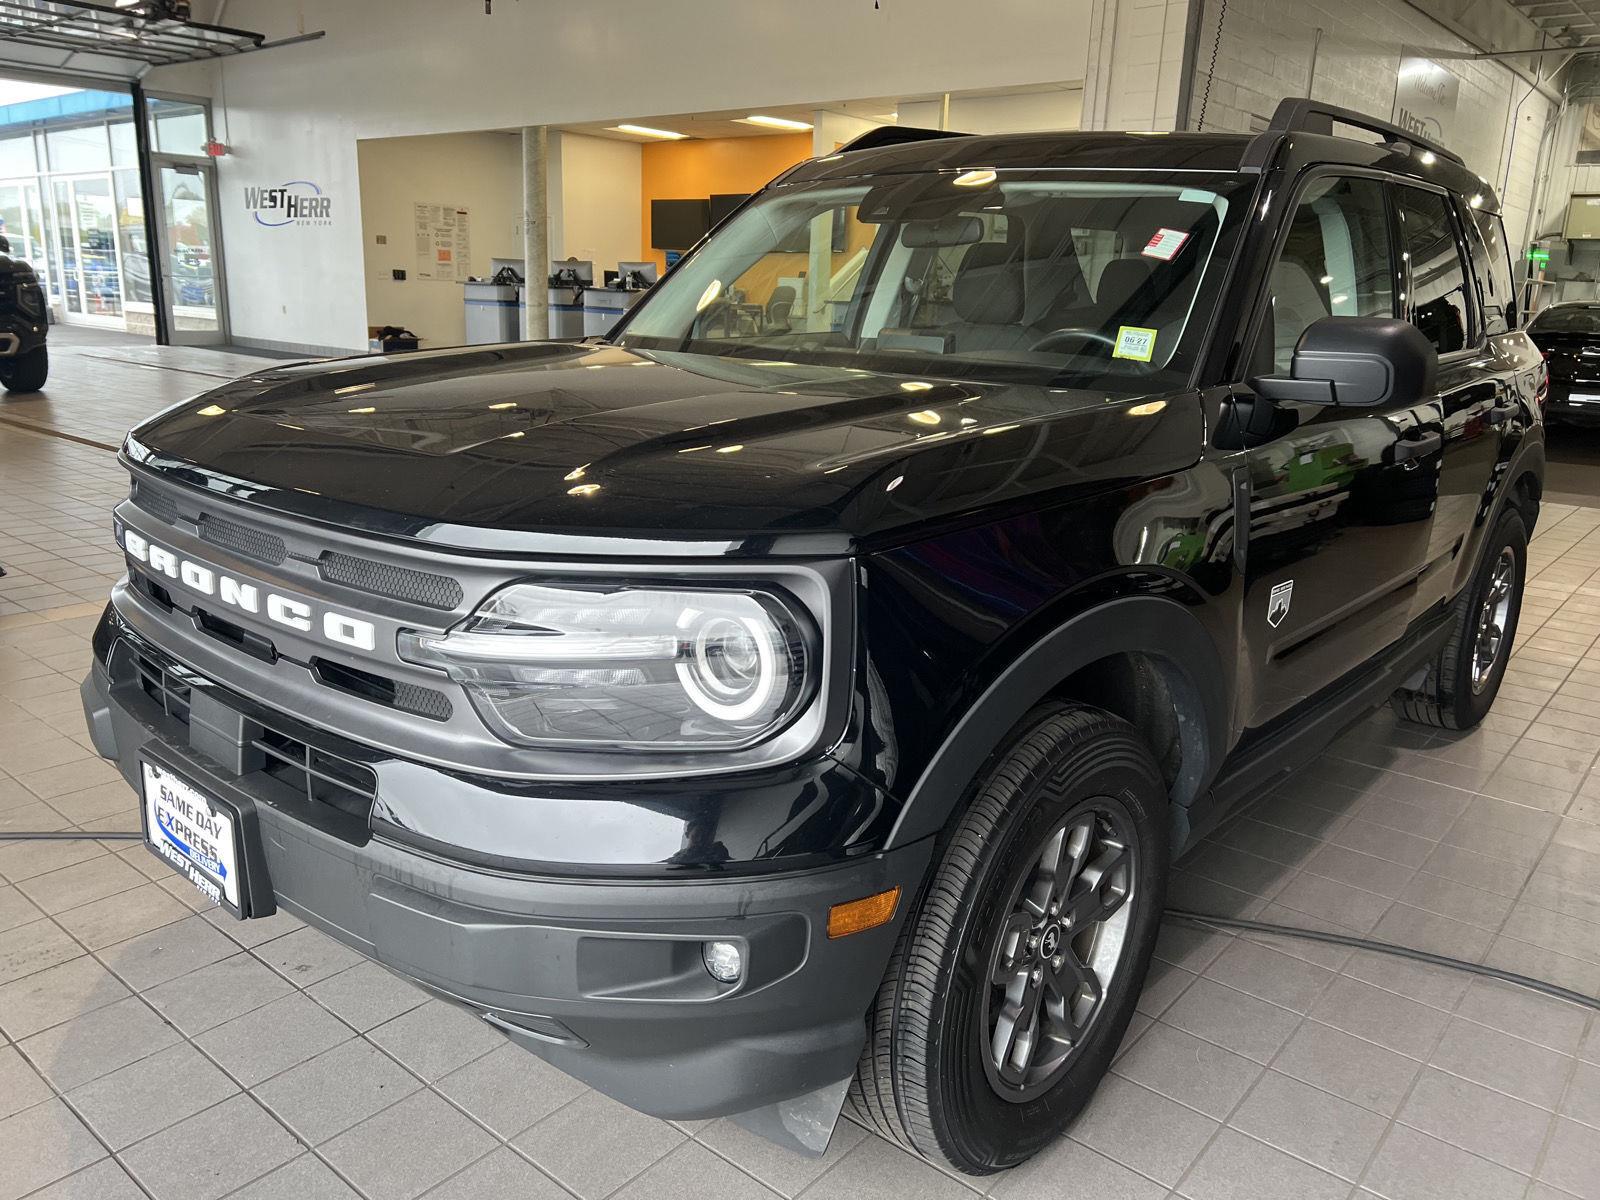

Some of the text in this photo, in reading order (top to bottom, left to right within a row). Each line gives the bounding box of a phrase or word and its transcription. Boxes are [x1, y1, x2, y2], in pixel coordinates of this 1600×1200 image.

[244, 187, 331, 218] WEST HERR
[1136, 337, 1148, 345] 27
[125, 529, 375, 651] BRONCO
[157, 804, 219, 862] EXPRESS
[159, 784, 194, 822] SAME
[195, 810, 223, 840] DAY
[159, 841, 192, 872] WEST
[188, 867, 221, 900] HERR
